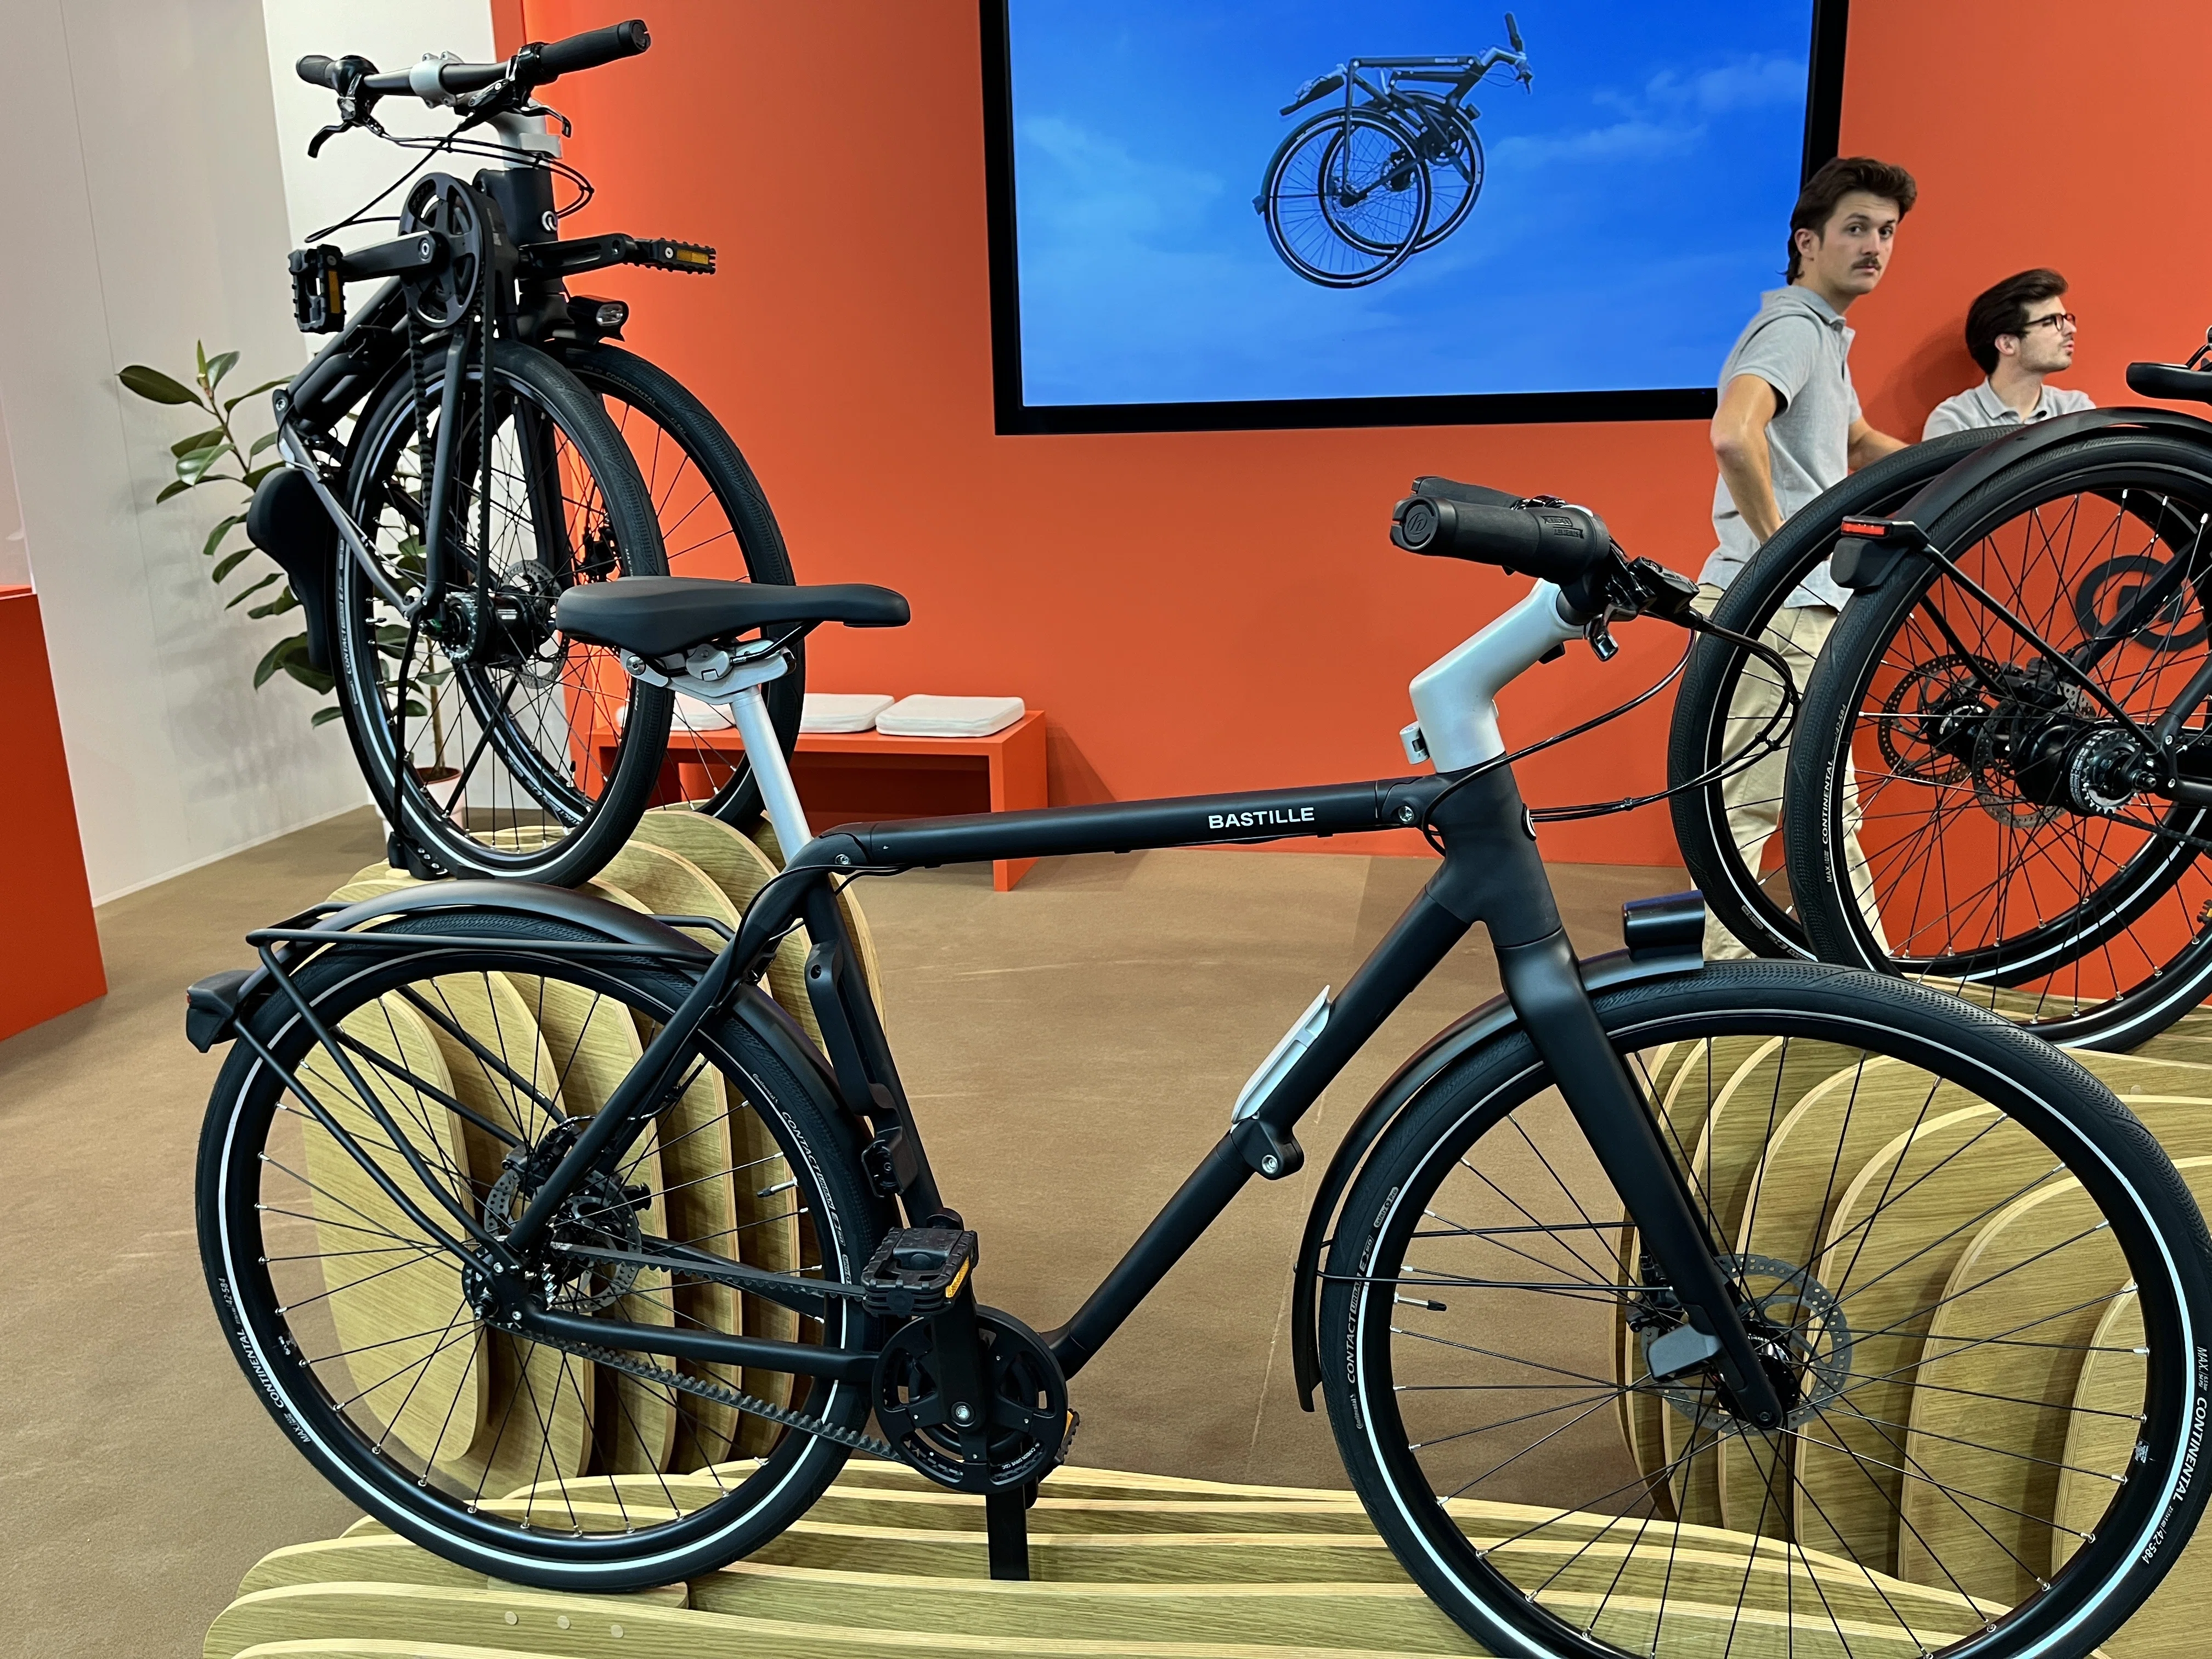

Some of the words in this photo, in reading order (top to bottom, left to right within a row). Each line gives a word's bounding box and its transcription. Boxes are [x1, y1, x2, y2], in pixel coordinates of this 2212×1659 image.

[1208, 807, 1315, 830] BASTILLE
[1822, 759, 1833, 845] CONTINENTAL
[782, 1111, 820, 1173] CONTACT
[817, 1174, 834, 1208] URBAN
[1375, 1207, 1388, 1227] Safety
[1389, 1188, 1398, 1201] Pro
[236, 1329, 284, 1408] CONTINENTAL
[1347, 1312, 1357, 1384] CONTACT
[2197, 1346, 2209, 1371] MAX.
[2172, 1396, 2208, 1502] CONTINENTAL
